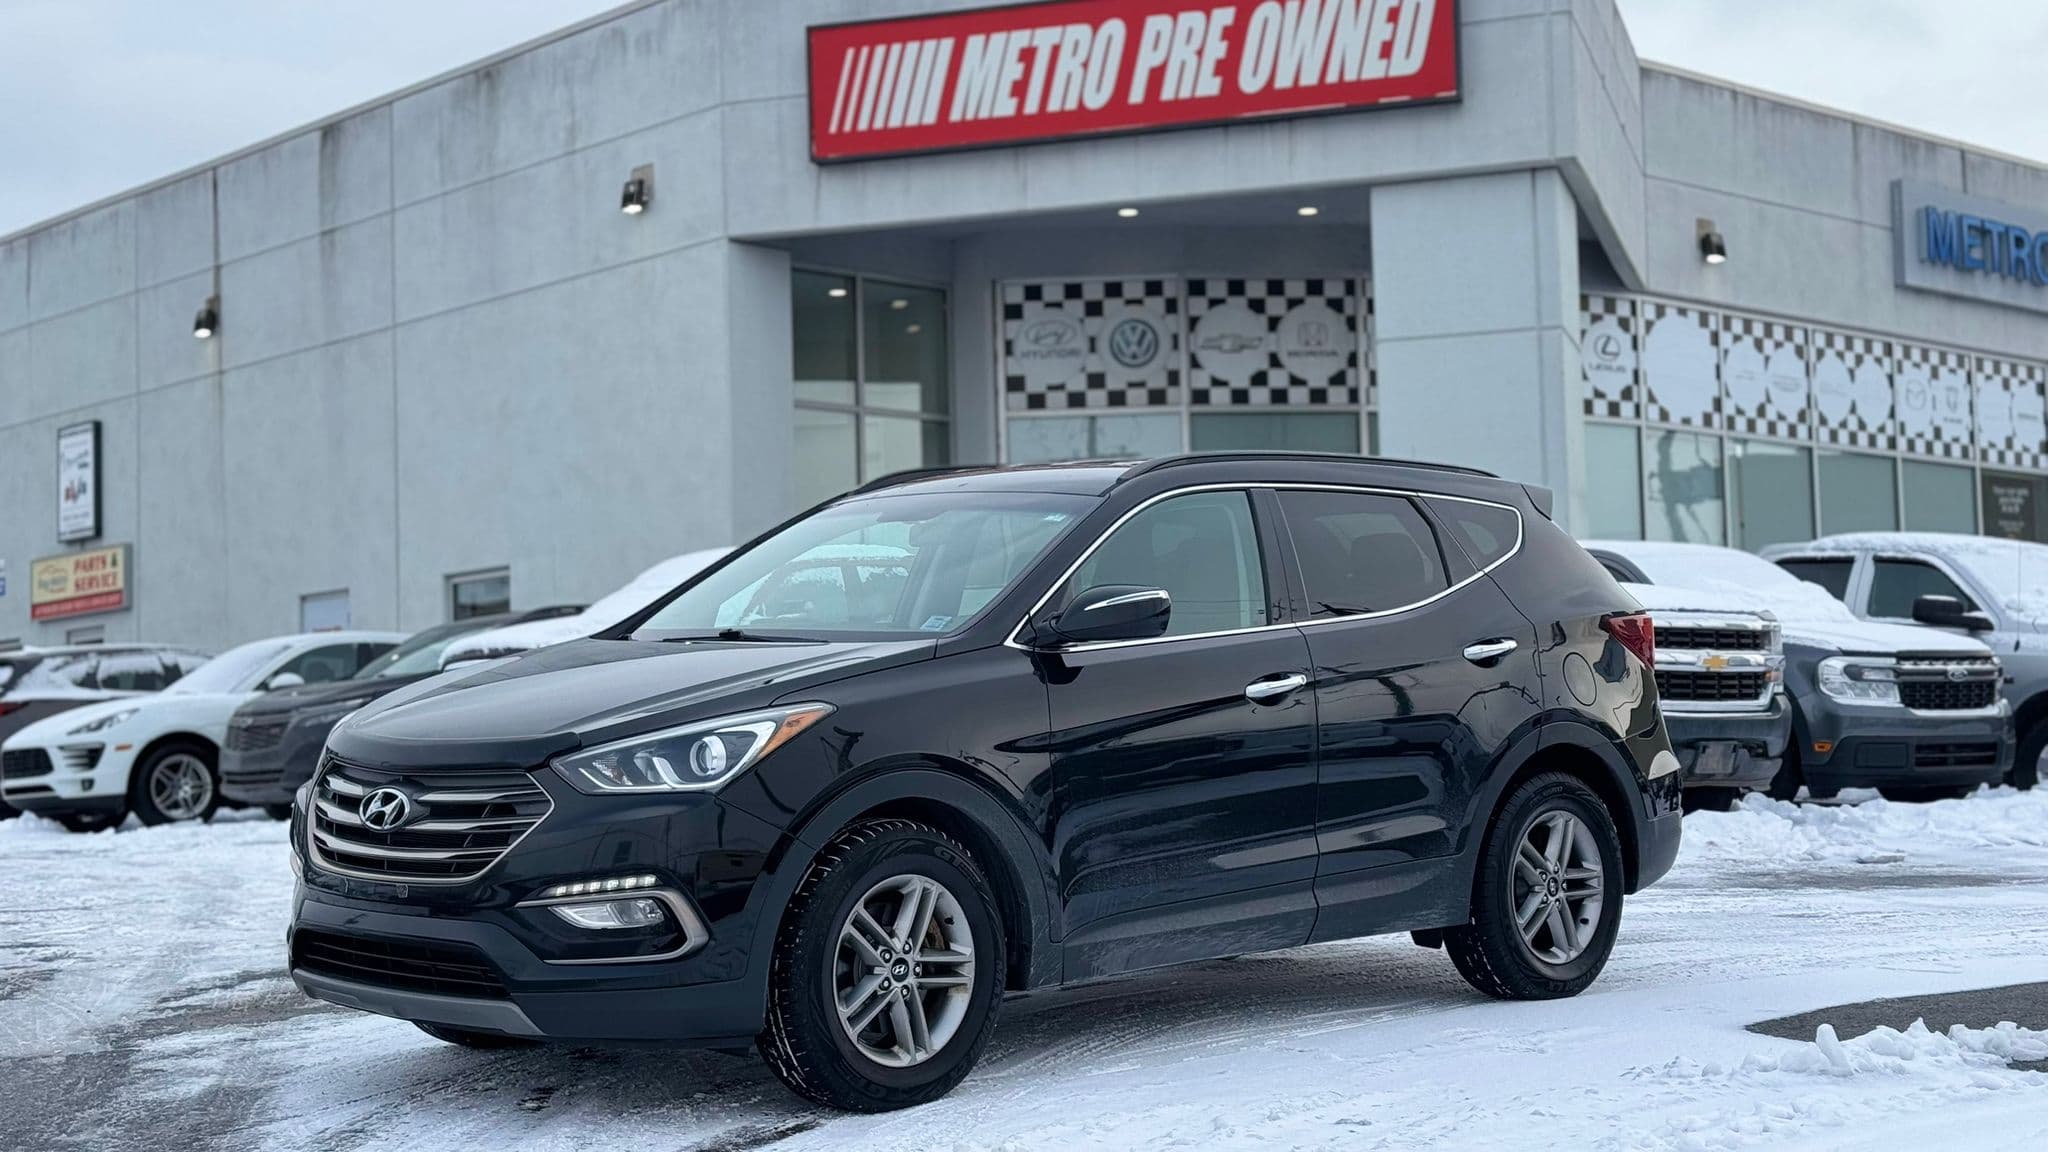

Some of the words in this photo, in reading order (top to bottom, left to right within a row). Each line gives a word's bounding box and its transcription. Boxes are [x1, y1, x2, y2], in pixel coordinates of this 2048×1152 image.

[949, 17, 1127, 123] METRO
[1127, 6, 1237, 105] PRE
[1238, 0, 1437, 94] OWNED
[73, 553, 107, 574] PARTS
[73, 572, 118, 592] SERVICE
